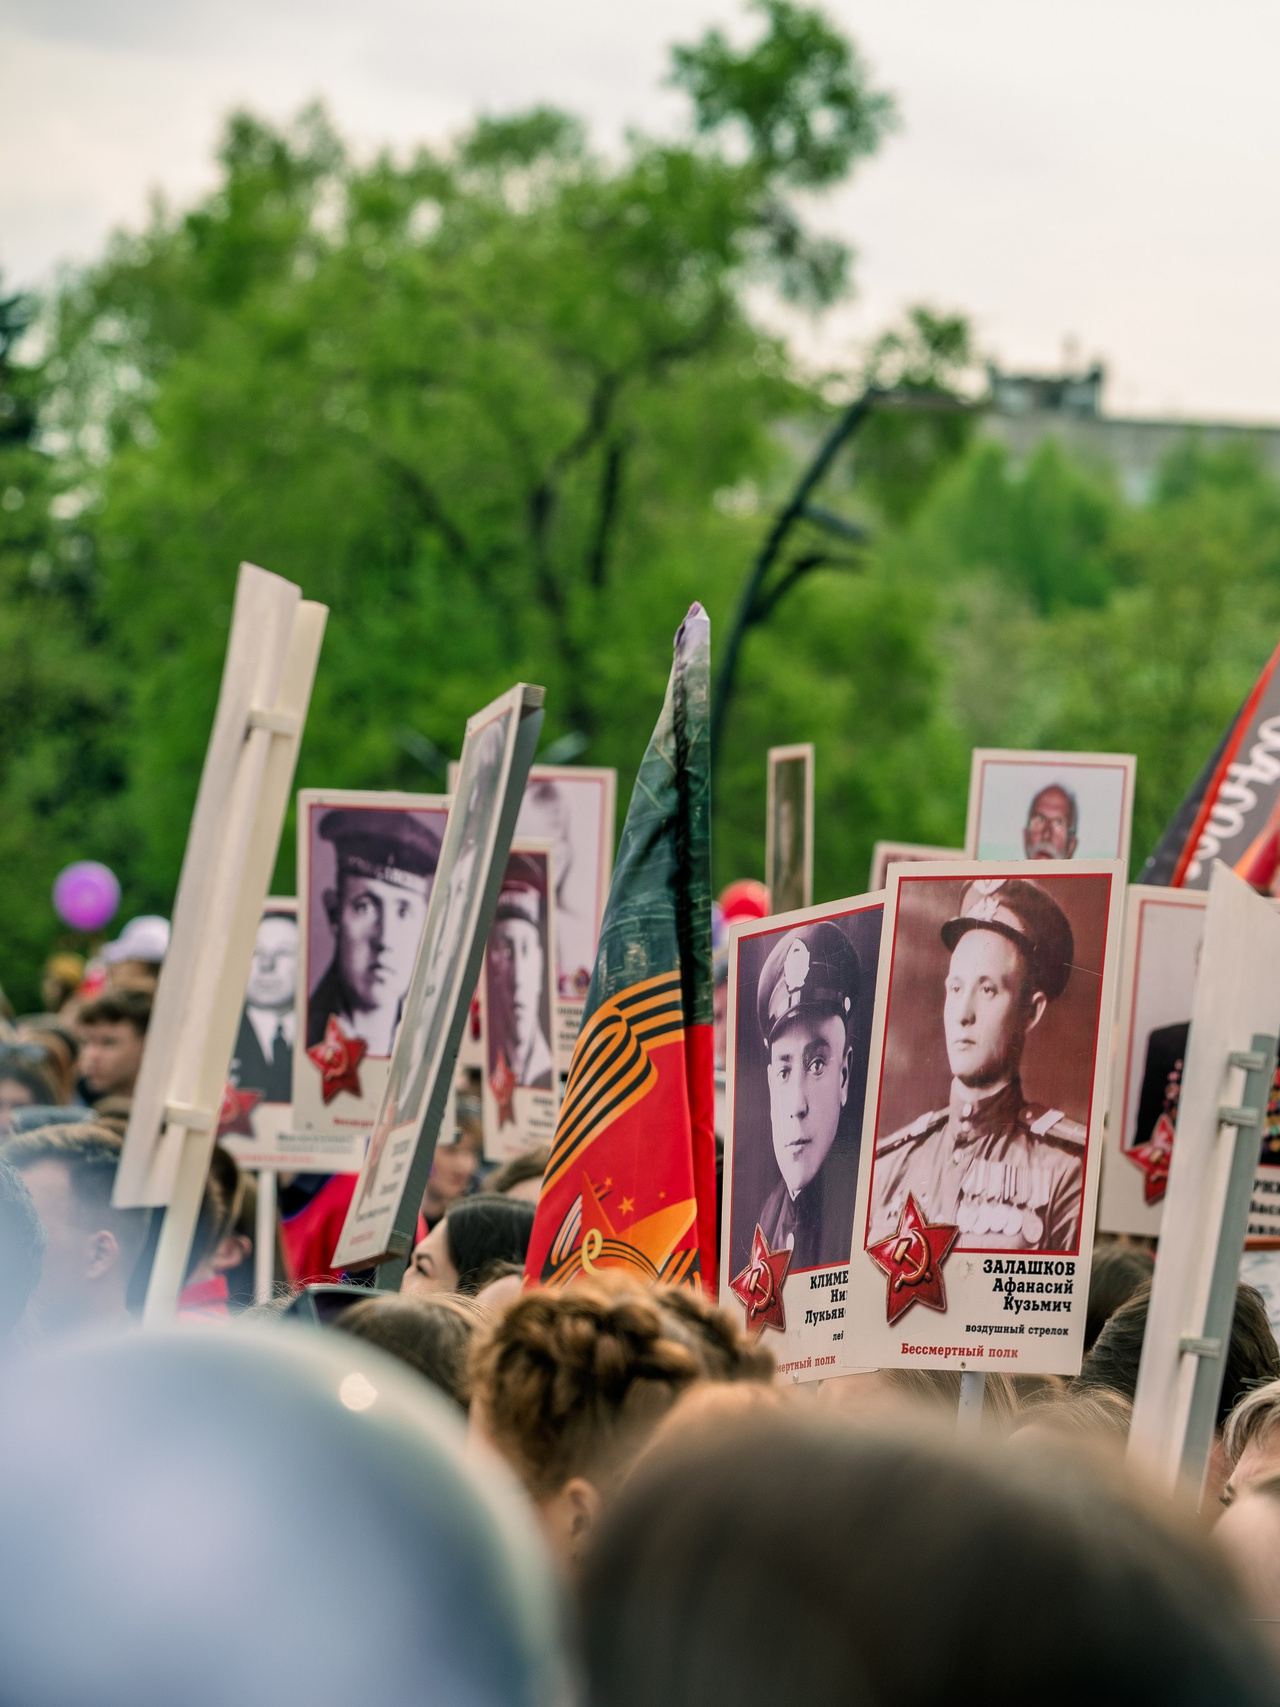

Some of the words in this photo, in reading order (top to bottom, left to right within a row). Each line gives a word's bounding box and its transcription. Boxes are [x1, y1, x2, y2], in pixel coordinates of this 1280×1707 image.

[983, 1259, 1076, 1276] ЗАЛАШКОВ
[810, 1270, 849, 1289] КЛИМЕ
[992, 1277, 1074, 1296] Афанасий
[1003, 1296, 1072, 1314] Кузьмич
[804, 1307, 846, 1327] Лукьян
[965, 1324, 1025, 1335] воздушный
[1028, 1327, 1069, 1337] стрелок
[901, 1343, 984, 1359] Бессмертный
[988, 1348, 1019, 1359] полк
[814, 1355, 836, 1367] полк
